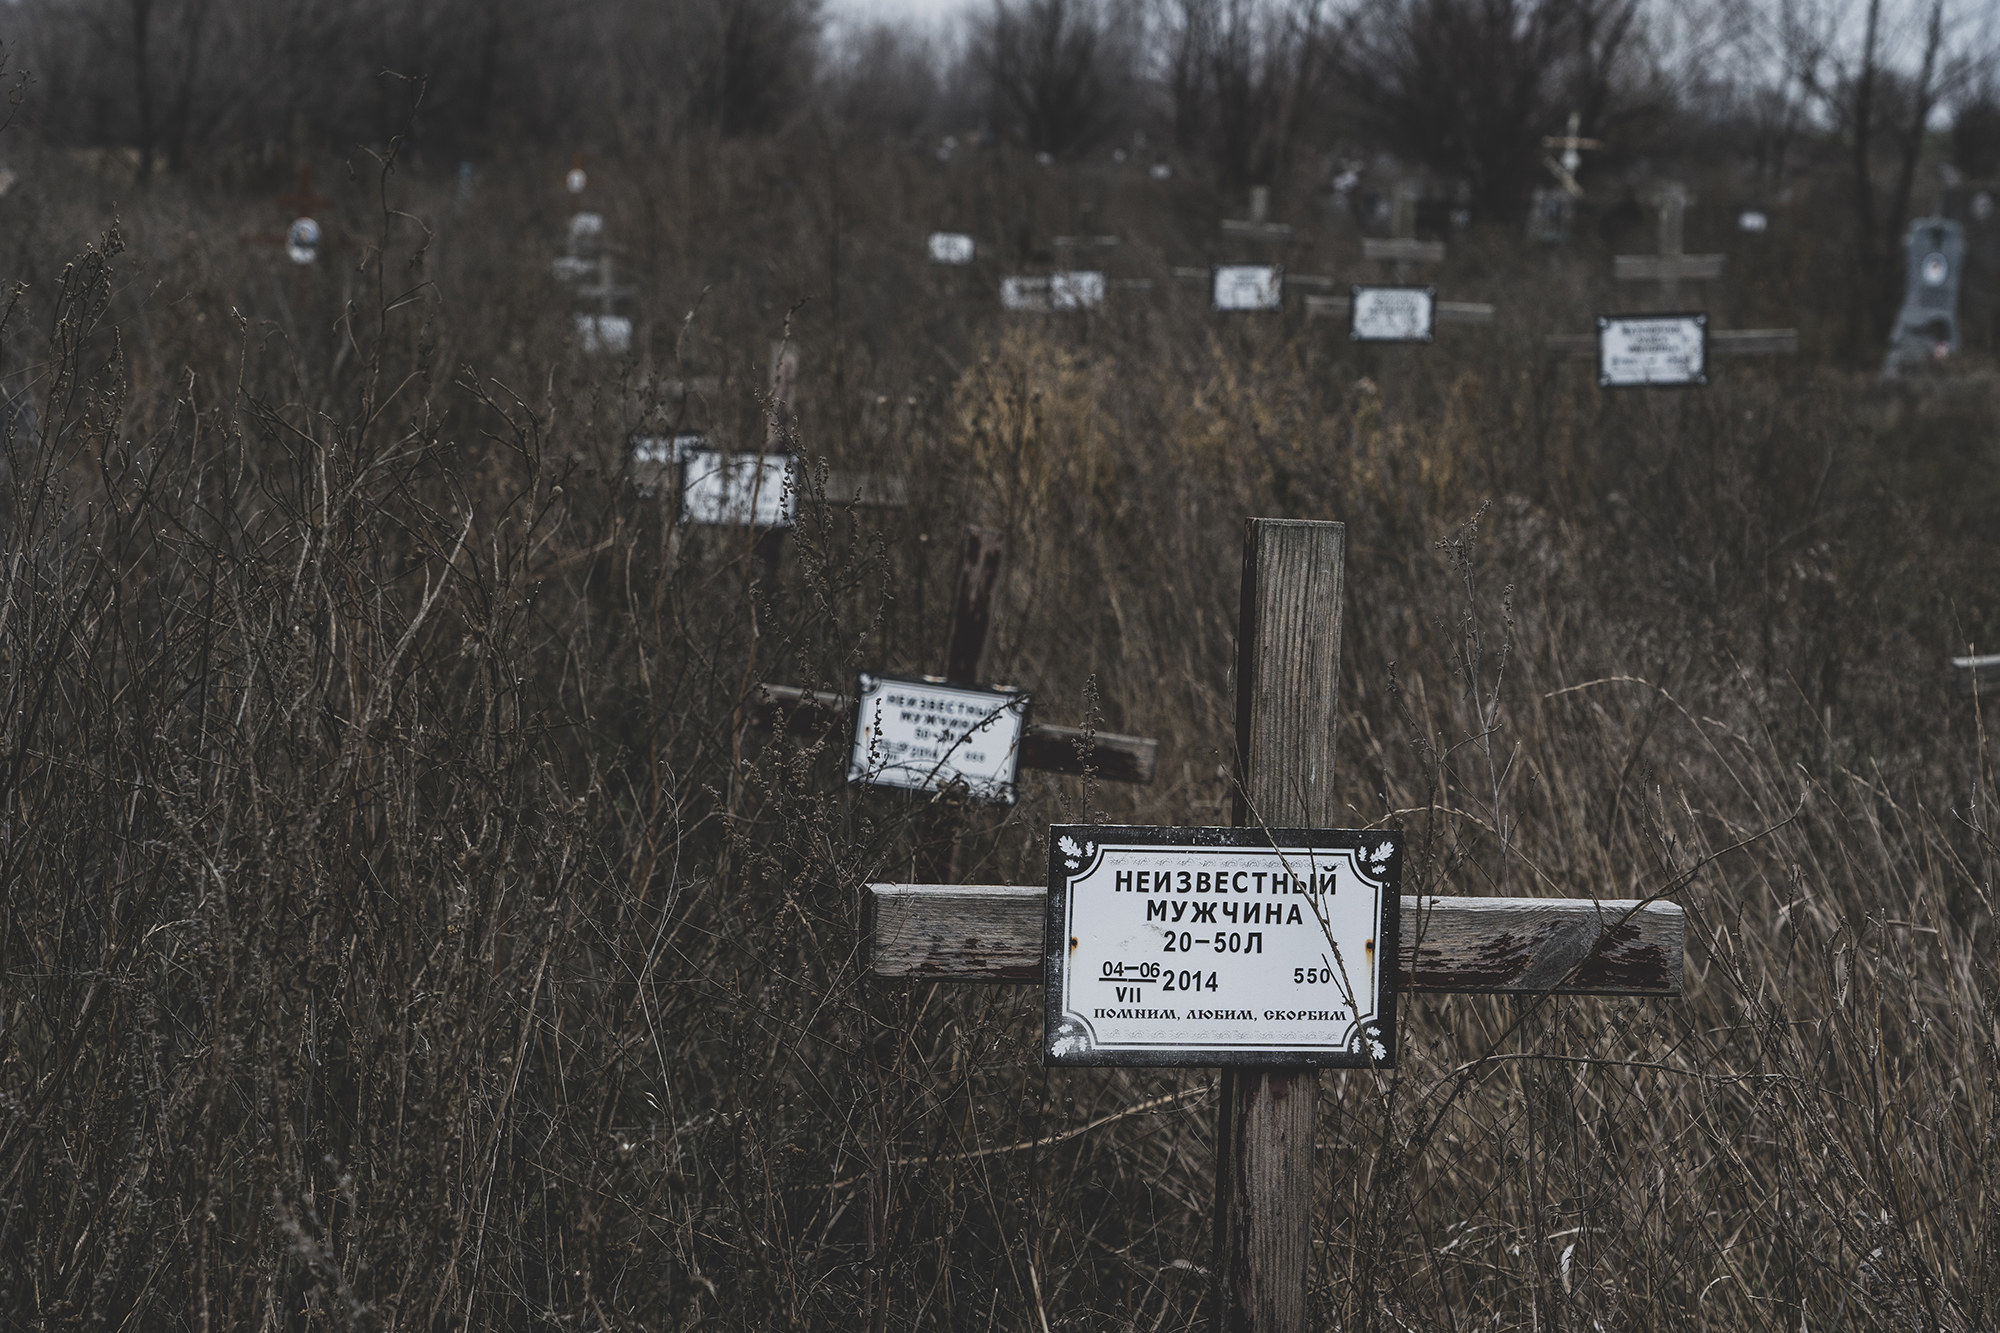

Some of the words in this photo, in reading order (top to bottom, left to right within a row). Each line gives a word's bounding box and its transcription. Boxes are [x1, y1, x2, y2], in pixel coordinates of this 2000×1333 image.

[1115, 865, 1337, 895] НЕИЗВЕСТНЫЙ
[1146, 900, 1303, 925] МУЖЧИНА
[1162, 970, 1218, 993] 2014
[1293, 968, 1330, 984] 550
[1116, 987, 1141, 1003] VII
[1094, 1008, 1181, 1021] ПОМНИМ,
[1186, 1008, 1257, 1022] ЛЮБИМ,
[1264, 1008, 1347, 1021] СКОРБИМ
